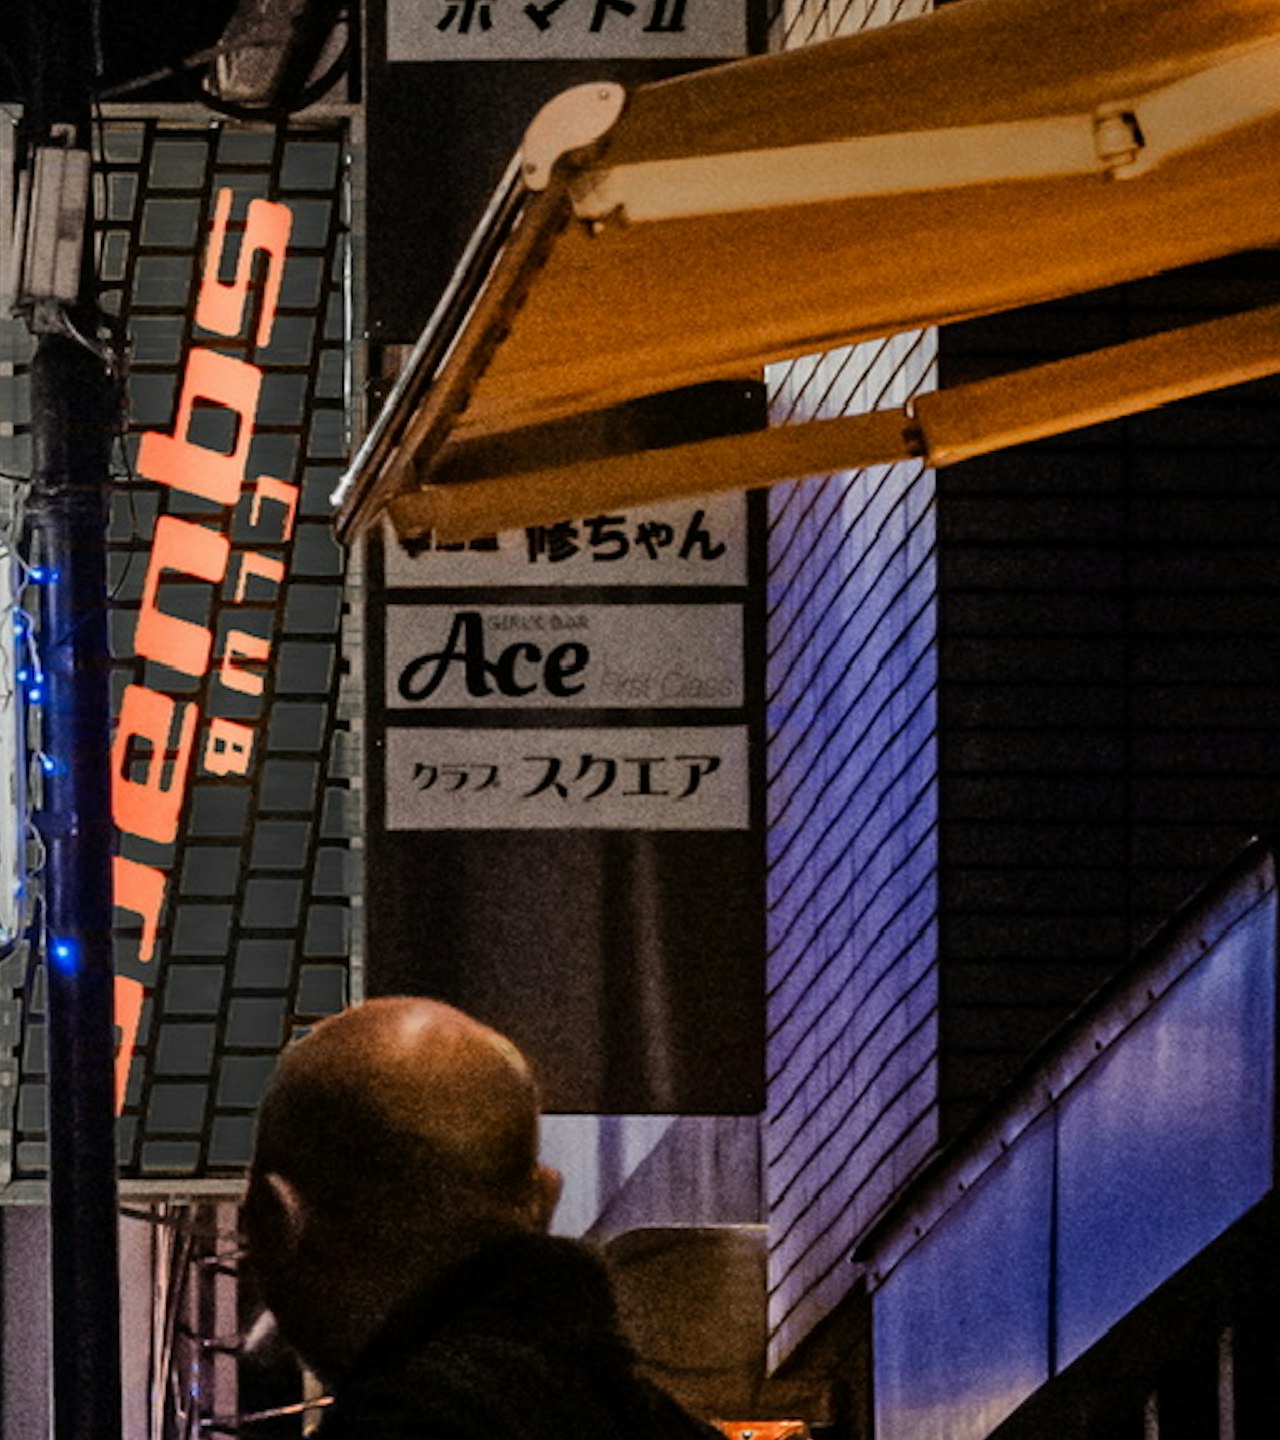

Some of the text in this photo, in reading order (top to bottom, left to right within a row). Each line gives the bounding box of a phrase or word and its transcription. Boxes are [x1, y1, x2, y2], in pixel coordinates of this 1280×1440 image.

[203, 473, 300, 779] CLUB
[398, 611, 590, 701] Ace
[521, 754, 721, 801] スクエア
